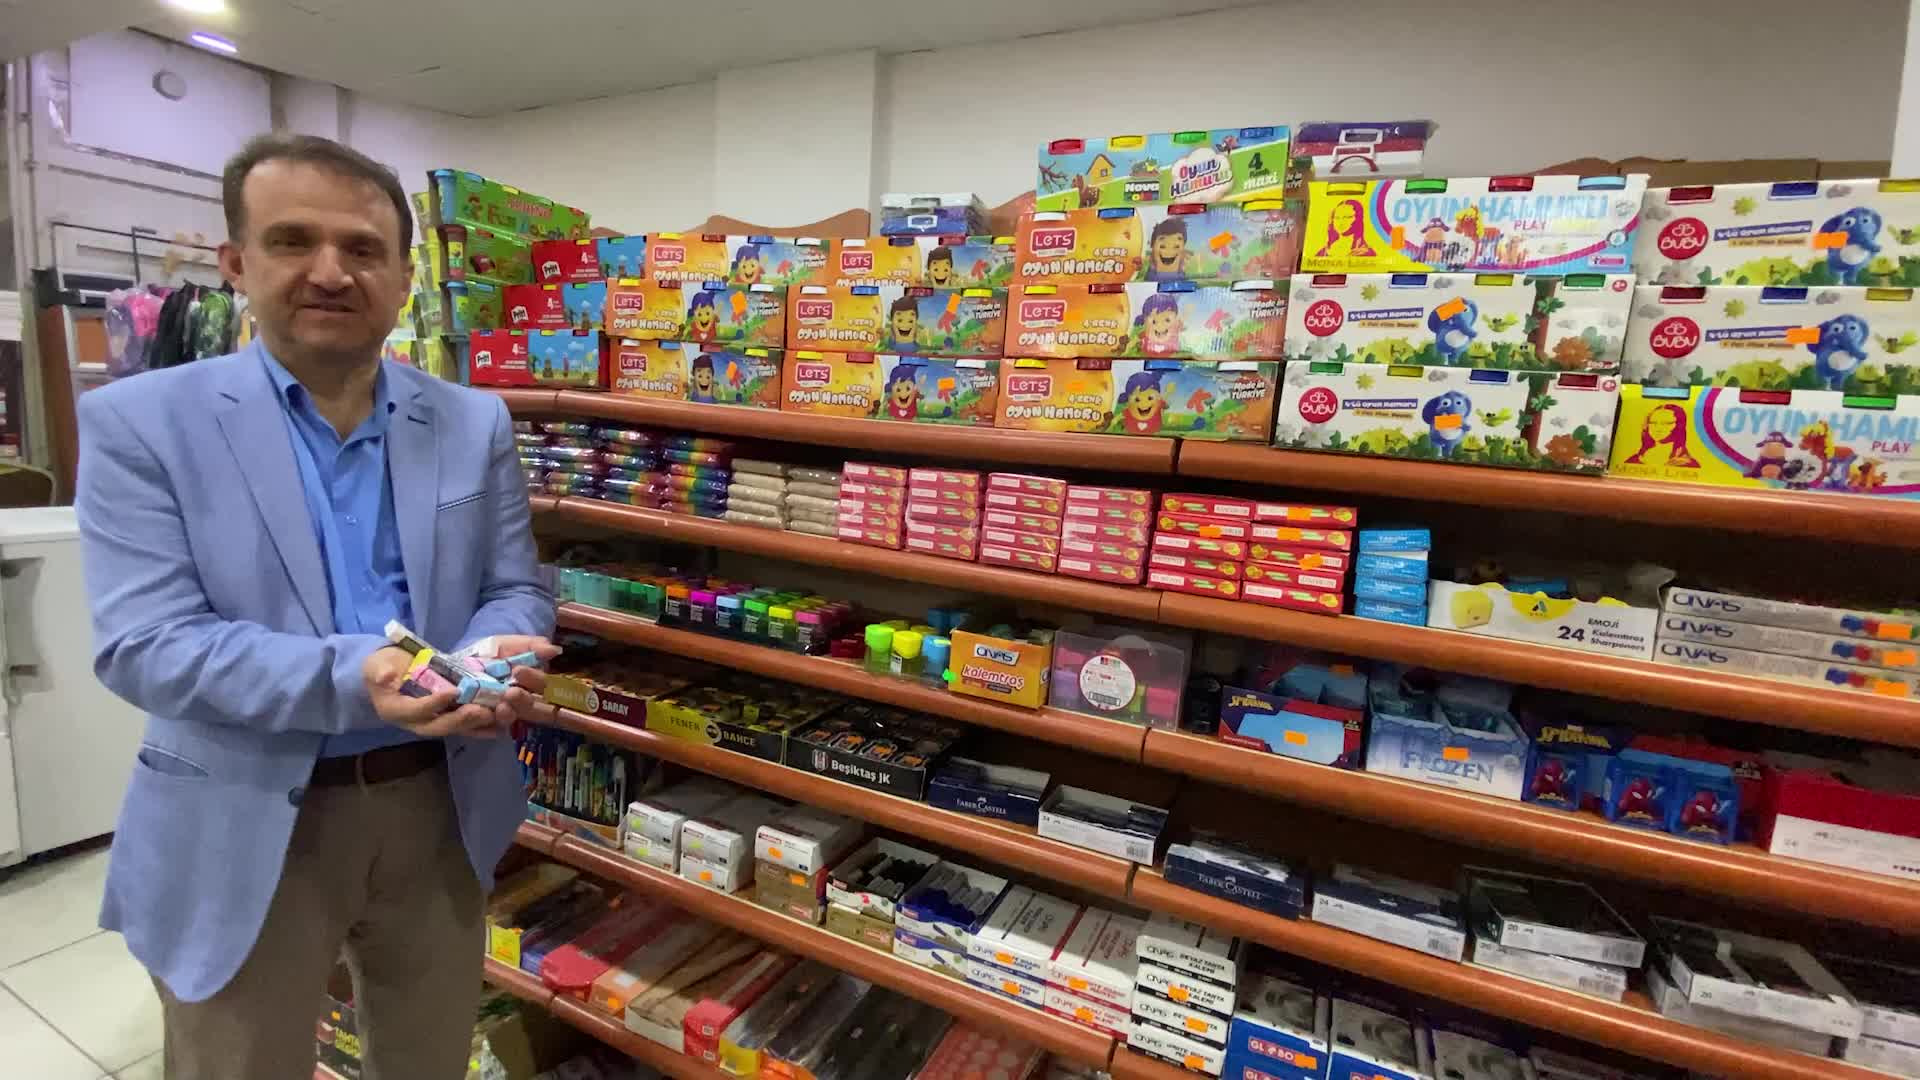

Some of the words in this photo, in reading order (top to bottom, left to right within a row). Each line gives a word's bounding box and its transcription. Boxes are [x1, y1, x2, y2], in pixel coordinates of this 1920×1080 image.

[1248, 152, 1264, 169] 4
[1179, 159, 1218, 179] Oyun
[1124, 182, 1160, 192] Nova
[1170, 171, 1232, 197] Hamuru
[1243, 173, 1279, 190] maxi
[1513, 220, 1547, 232] PLAY
[1660, 233, 1706, 251] BUBU
[580, 252, 590, 264] 4
[546, 298, 555, 310] 4
[1306, 314, 1342, 328] BUBU
[511, 343, 520, 355] 4
[1652, 333, 1698, 349] BUBU
[1234, 381, 1256, 390] Made
[1256, 380, 1265, 389] in
[1300, 401, 1336, 415] BUBU
[1871, 440, 1912, 455] PLAY
[1557, 625, 1586, 642] 24
[602, 699, 630, 717] SARAY
[669, 716, 701, 732] FENER
[831, 759, 877, 783] Beşiktaş
[877, 772, 892, 785] JK
[1404, 751, 1496, 784] FROZEN
